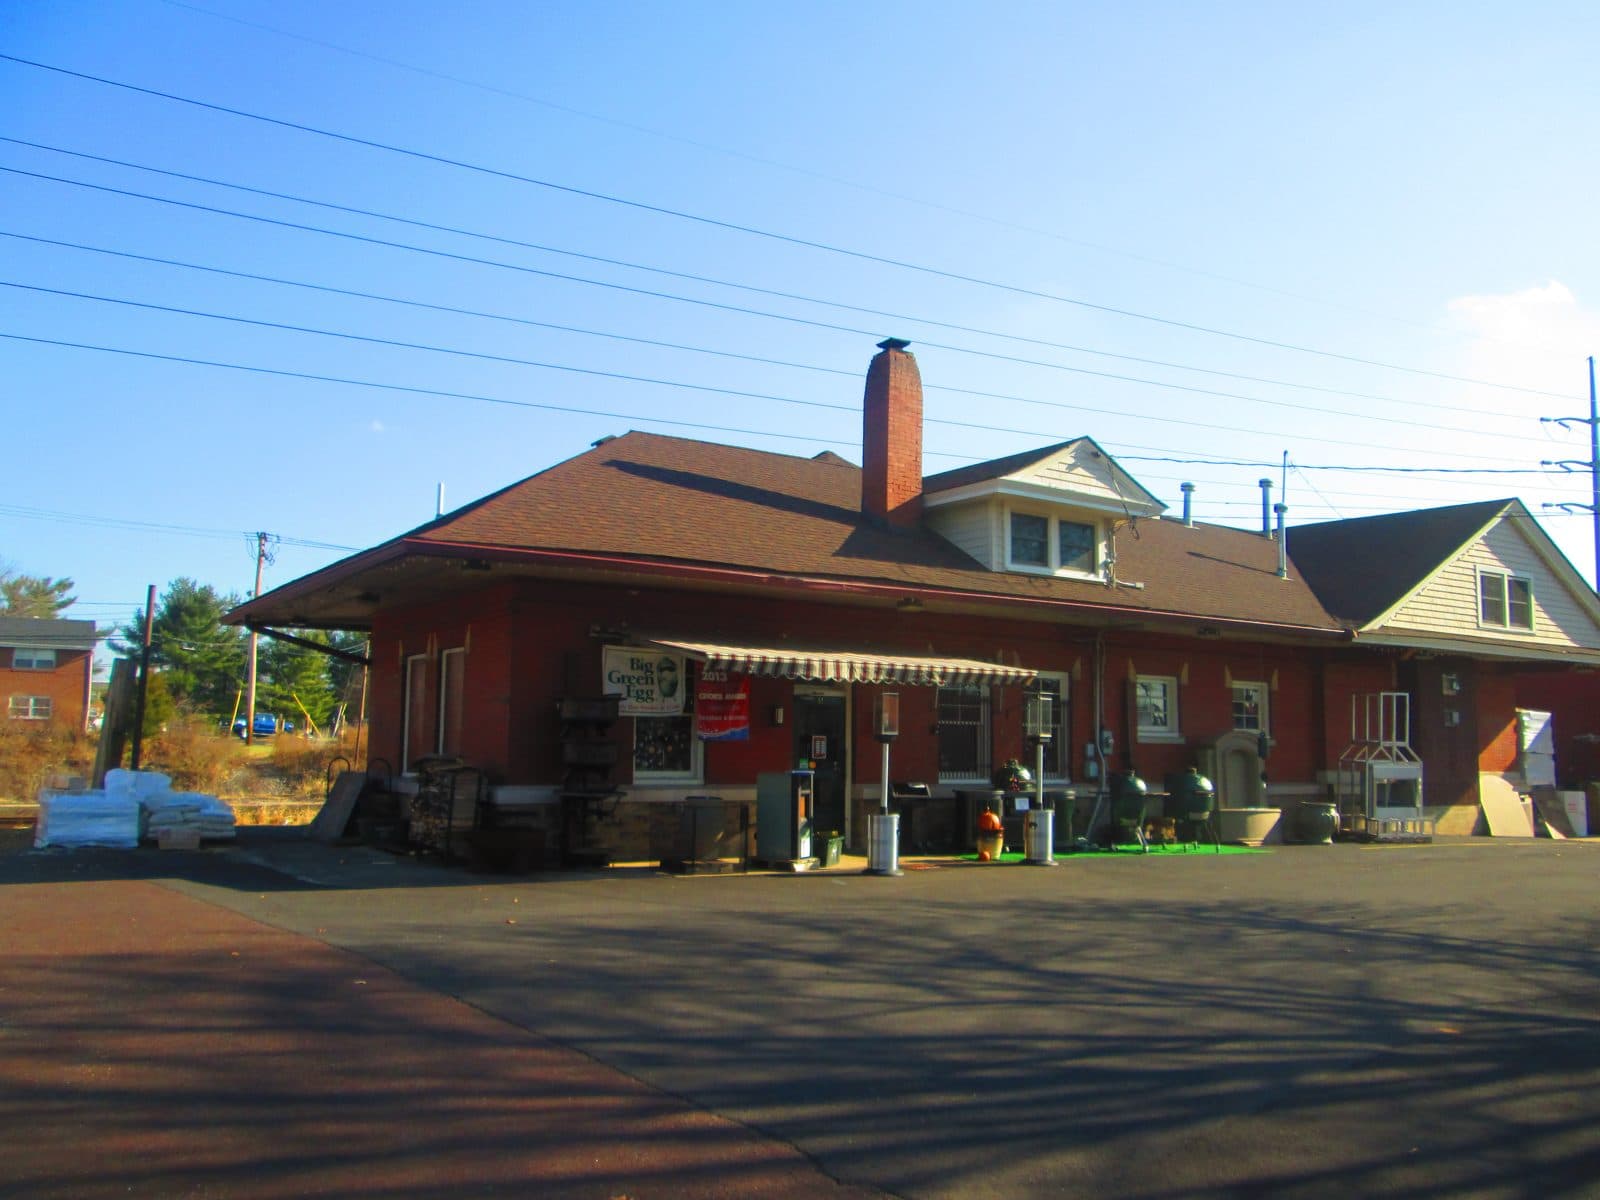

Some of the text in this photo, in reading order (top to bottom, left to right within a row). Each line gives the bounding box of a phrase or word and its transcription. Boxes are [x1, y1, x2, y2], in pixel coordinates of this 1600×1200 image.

[630, 657, 653, 675] Big
[608, 671, 654, 685] Green
[626, 685, 654, 703] Egg
